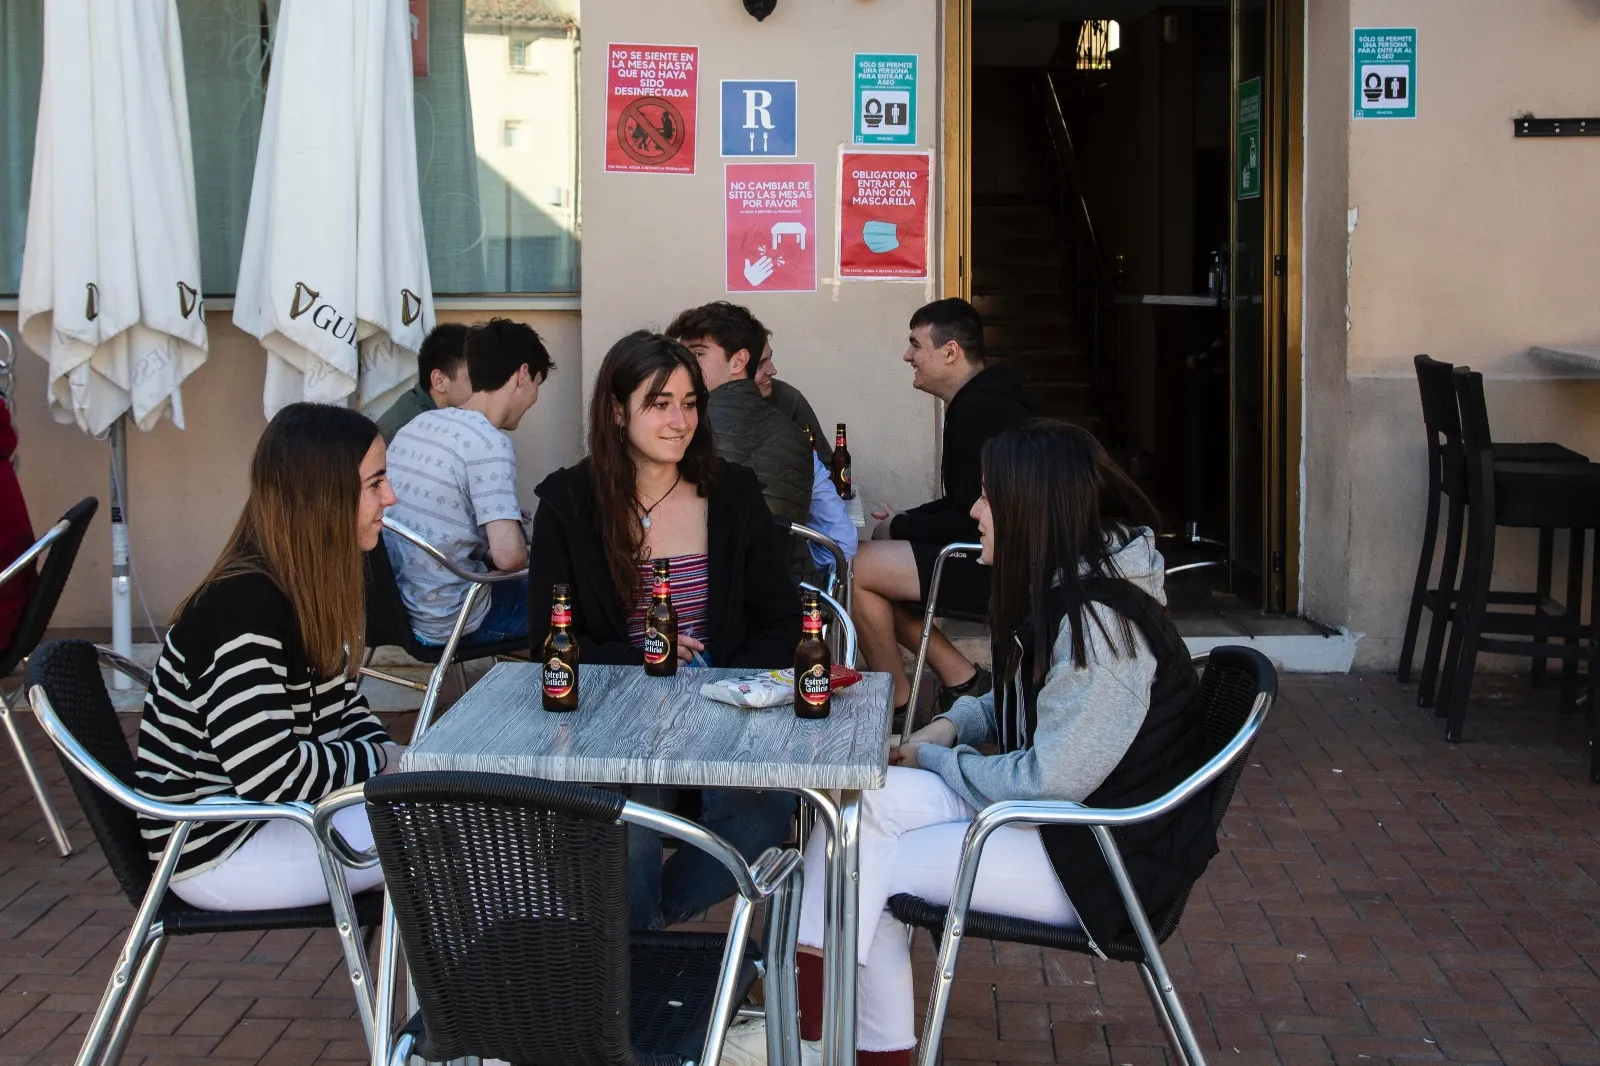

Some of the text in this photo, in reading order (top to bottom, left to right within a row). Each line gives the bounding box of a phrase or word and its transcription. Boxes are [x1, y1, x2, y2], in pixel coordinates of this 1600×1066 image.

[612, 51, 627, 59] NO
[645, 52, 678, 60] SIENTE
[681, 53, 693, 61] EN
[612, 60, 693, 70] LA MESA HASTA
[618, 69, 686, 79] QUE NO HAYA
[640, 79, 664, 87] SIDO
[615, 87, 688, 97] DESINFECTADA
[743, 90, 775, 129] R
[852, 171, 917, 179] OBLIGATORIO
[731, 182, 746, 190] NO
[748, 182, 794, 190] CAMBIAR
[729, 191, 755, 199] SITIO
[859, 187, 886, 196] BAÑO
[853, 197, 916, 205] MASCARILLA
[312, 304, 356, 349] GUI
[545, 670, 568, 679] Estrella
[545, 678, 566, 686] Galicia
